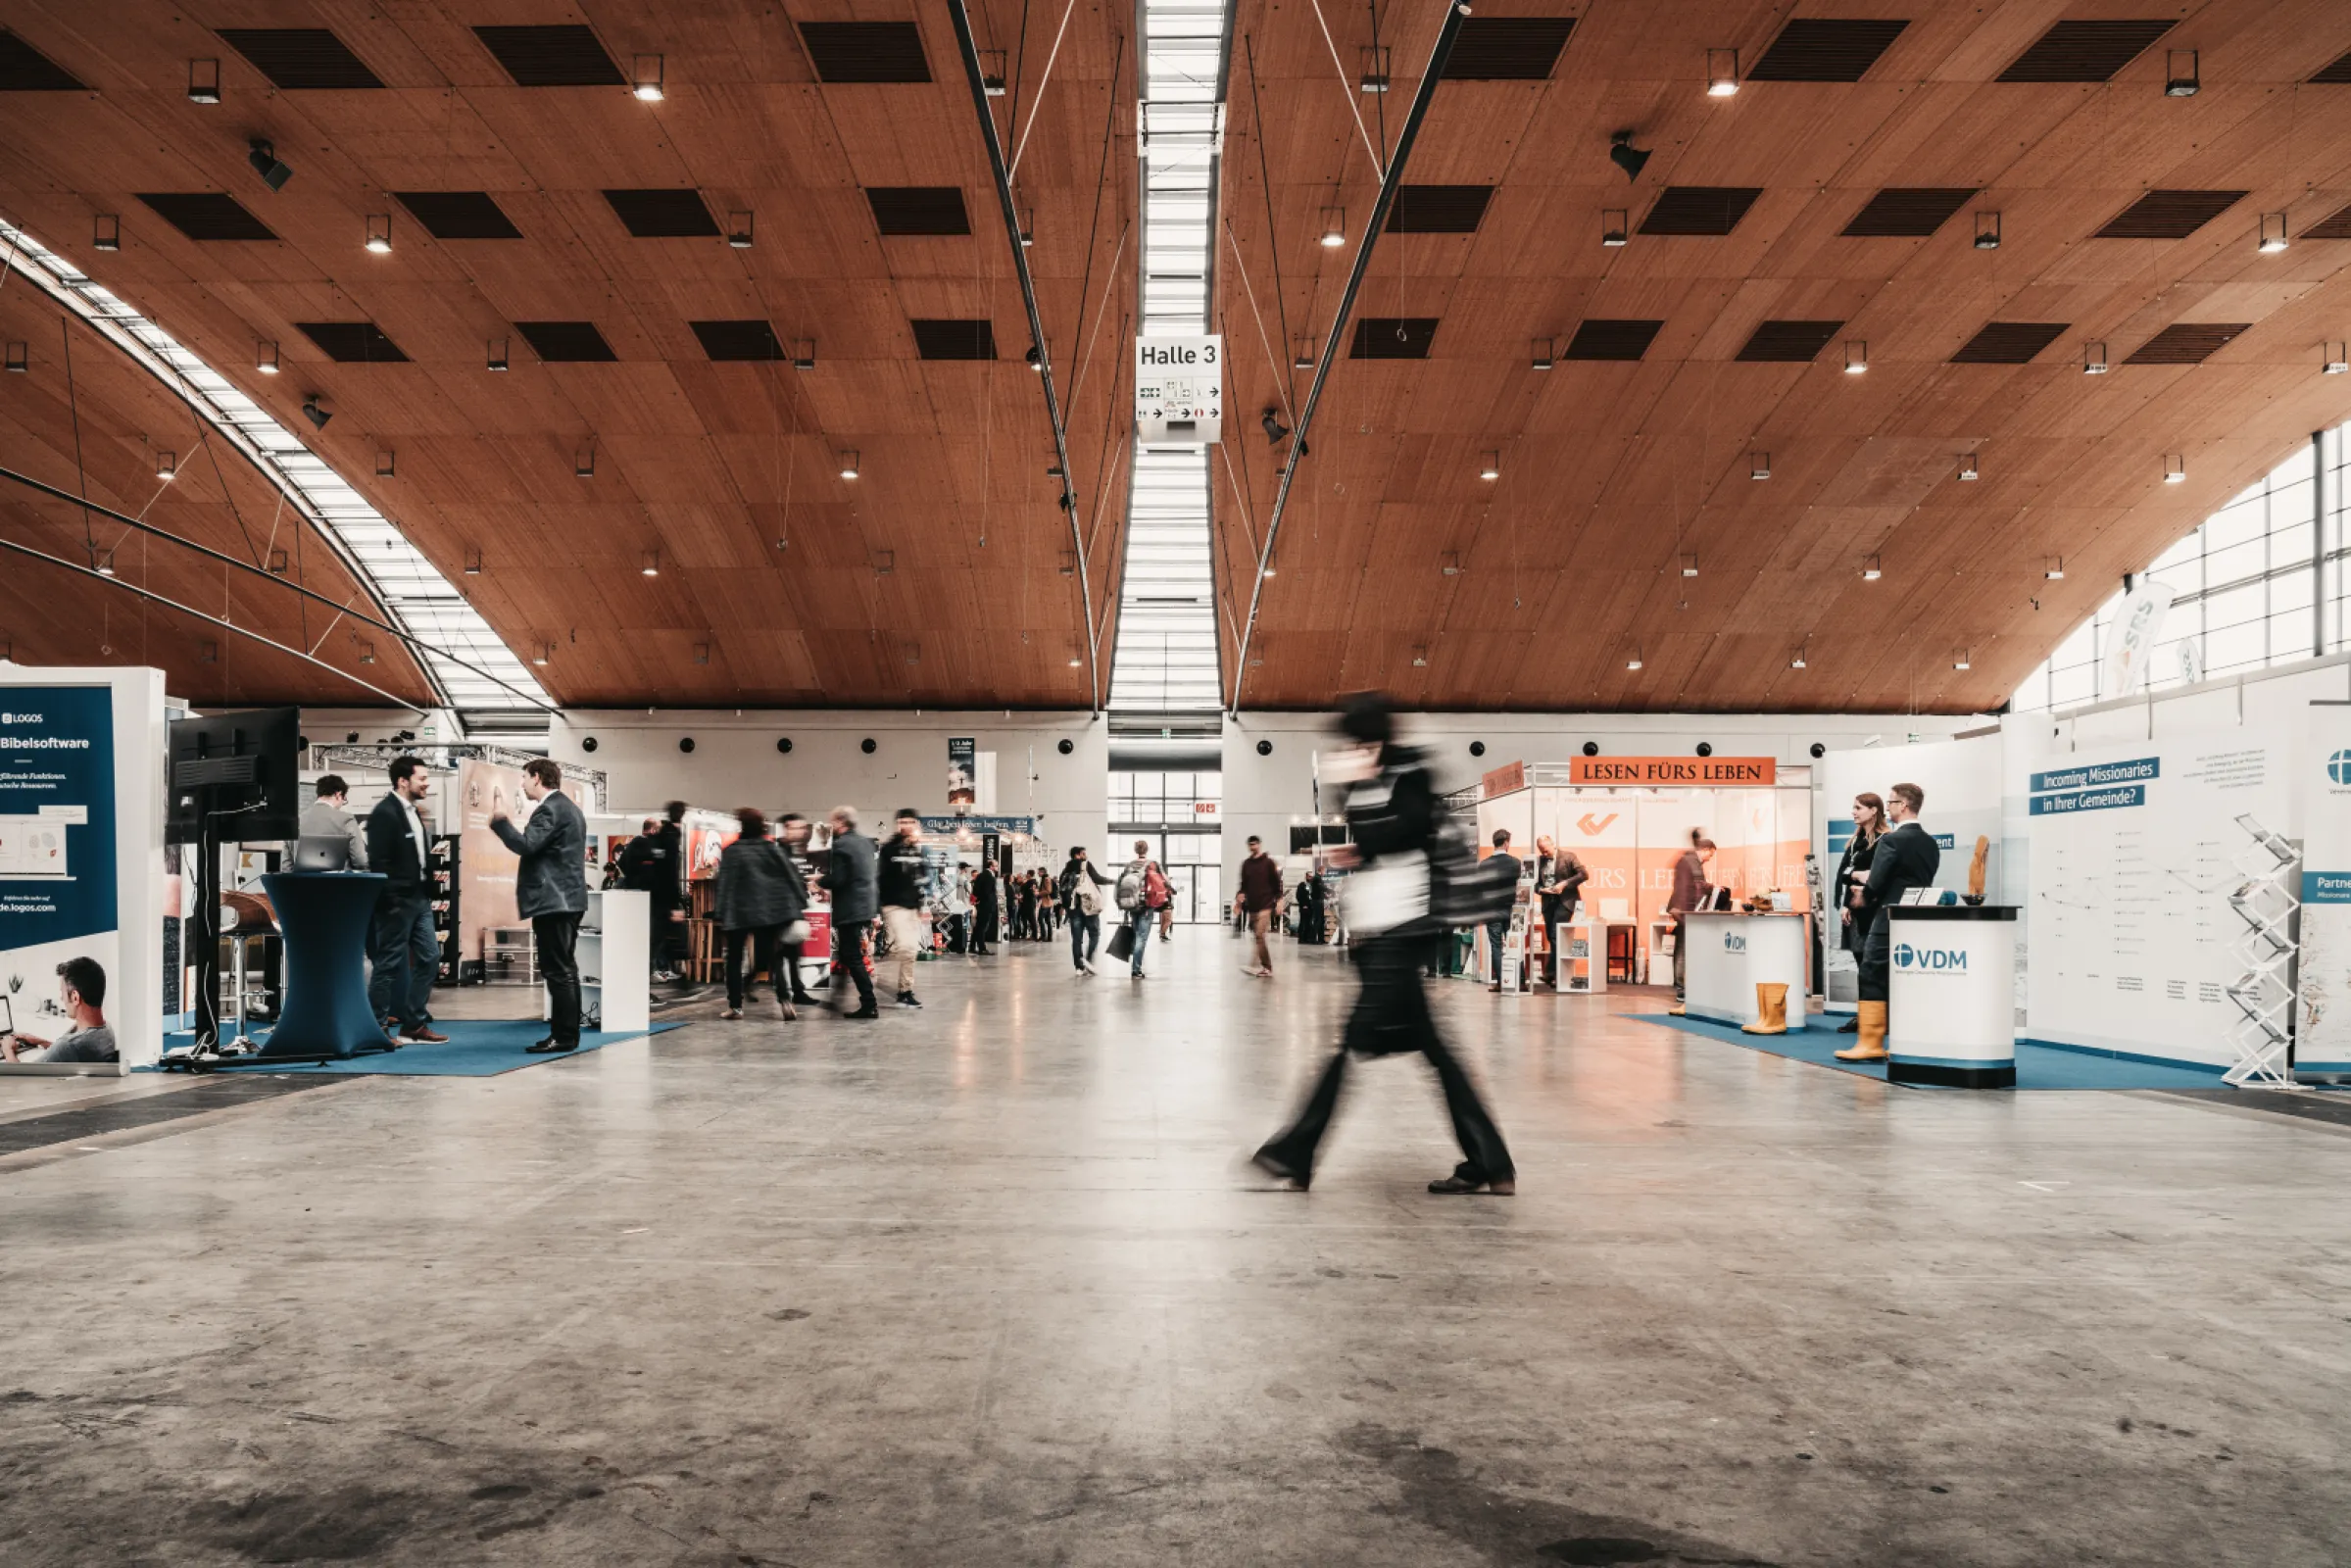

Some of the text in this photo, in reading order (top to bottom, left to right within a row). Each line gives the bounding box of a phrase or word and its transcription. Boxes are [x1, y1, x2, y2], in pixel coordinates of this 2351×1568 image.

[1141, 345, 1216, 365] Halle 3
[13, 713, 43, 723] LOGOS
[0, 737, 89, 749] Bibelsoftware
[1583, 761, 1762, 780] LESEN FÜRS LEBEN
[2043, 761, 2153, 789] Incoming Missionaries
[2043, 788, 2136, 811] in Ihrer Gemeinde?
[1583, 864, 1626, 889] ÜRS
[1916, 949, 1967, 969] VDM
